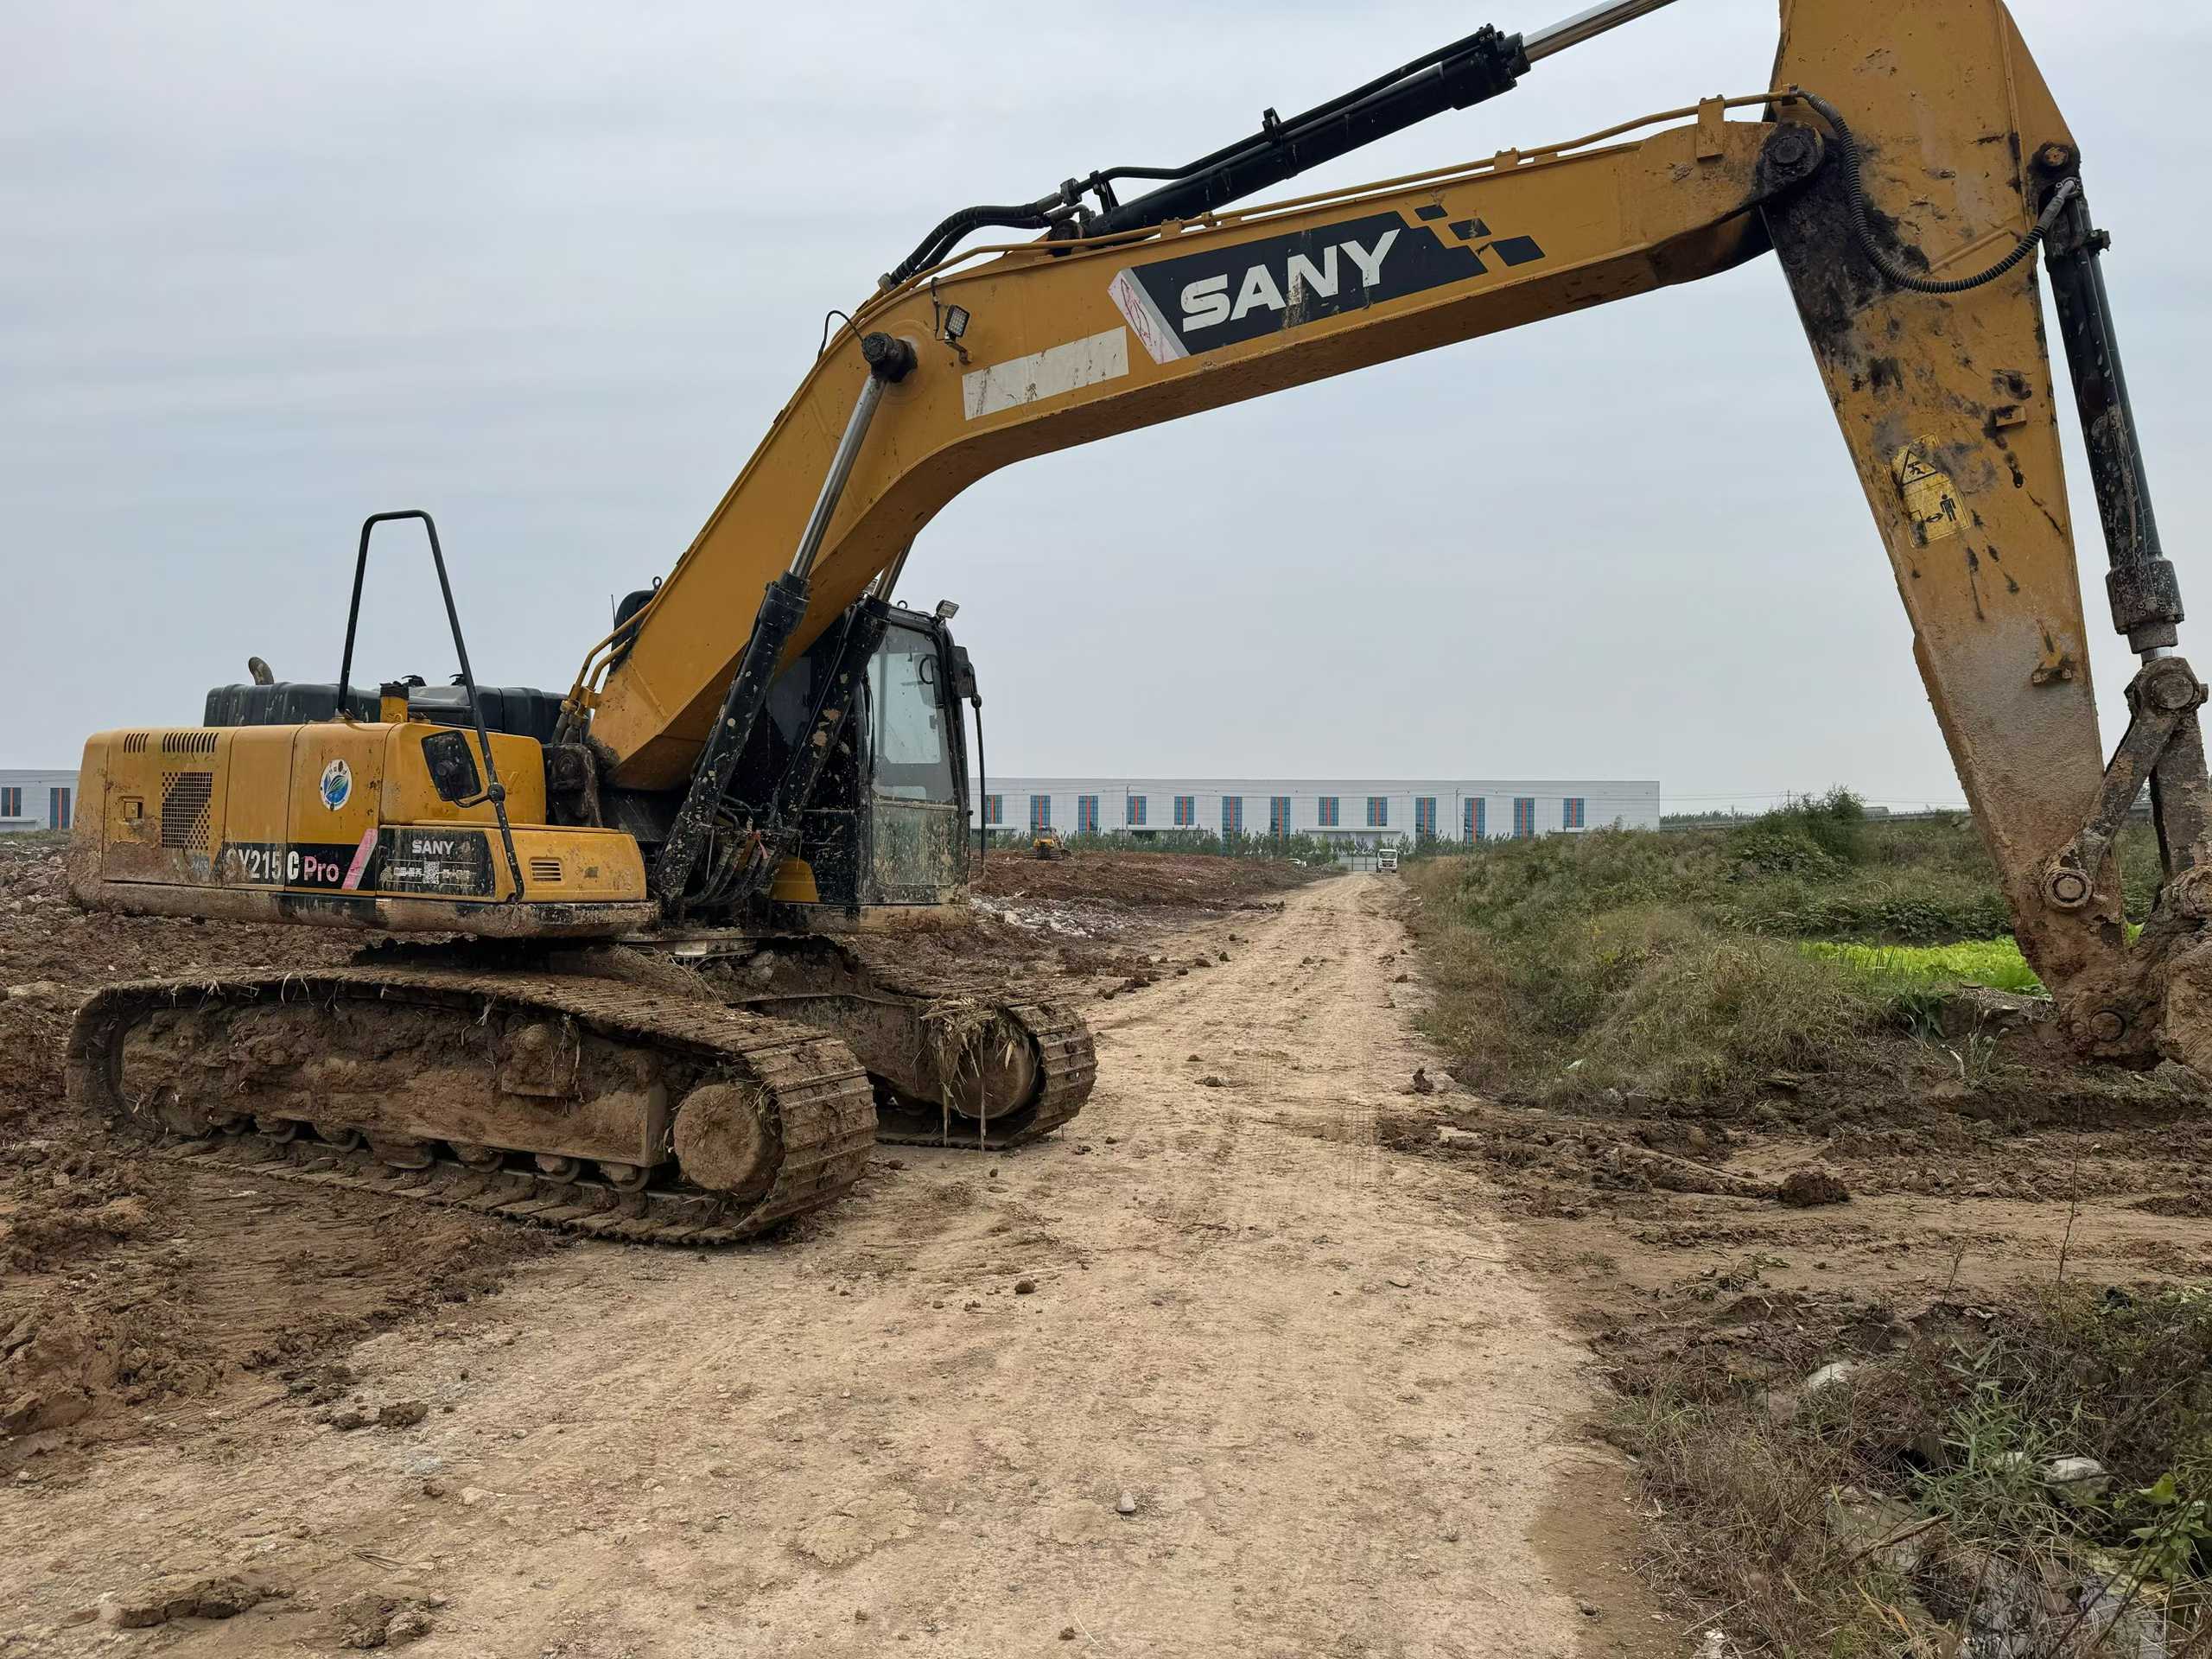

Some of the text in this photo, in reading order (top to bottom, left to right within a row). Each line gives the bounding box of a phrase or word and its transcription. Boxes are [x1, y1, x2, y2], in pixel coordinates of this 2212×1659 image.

[1180, 228, 1401, 332] SANY
[411, 839, 454, 855] SANY
[303, 855, 340, 882] Pro
